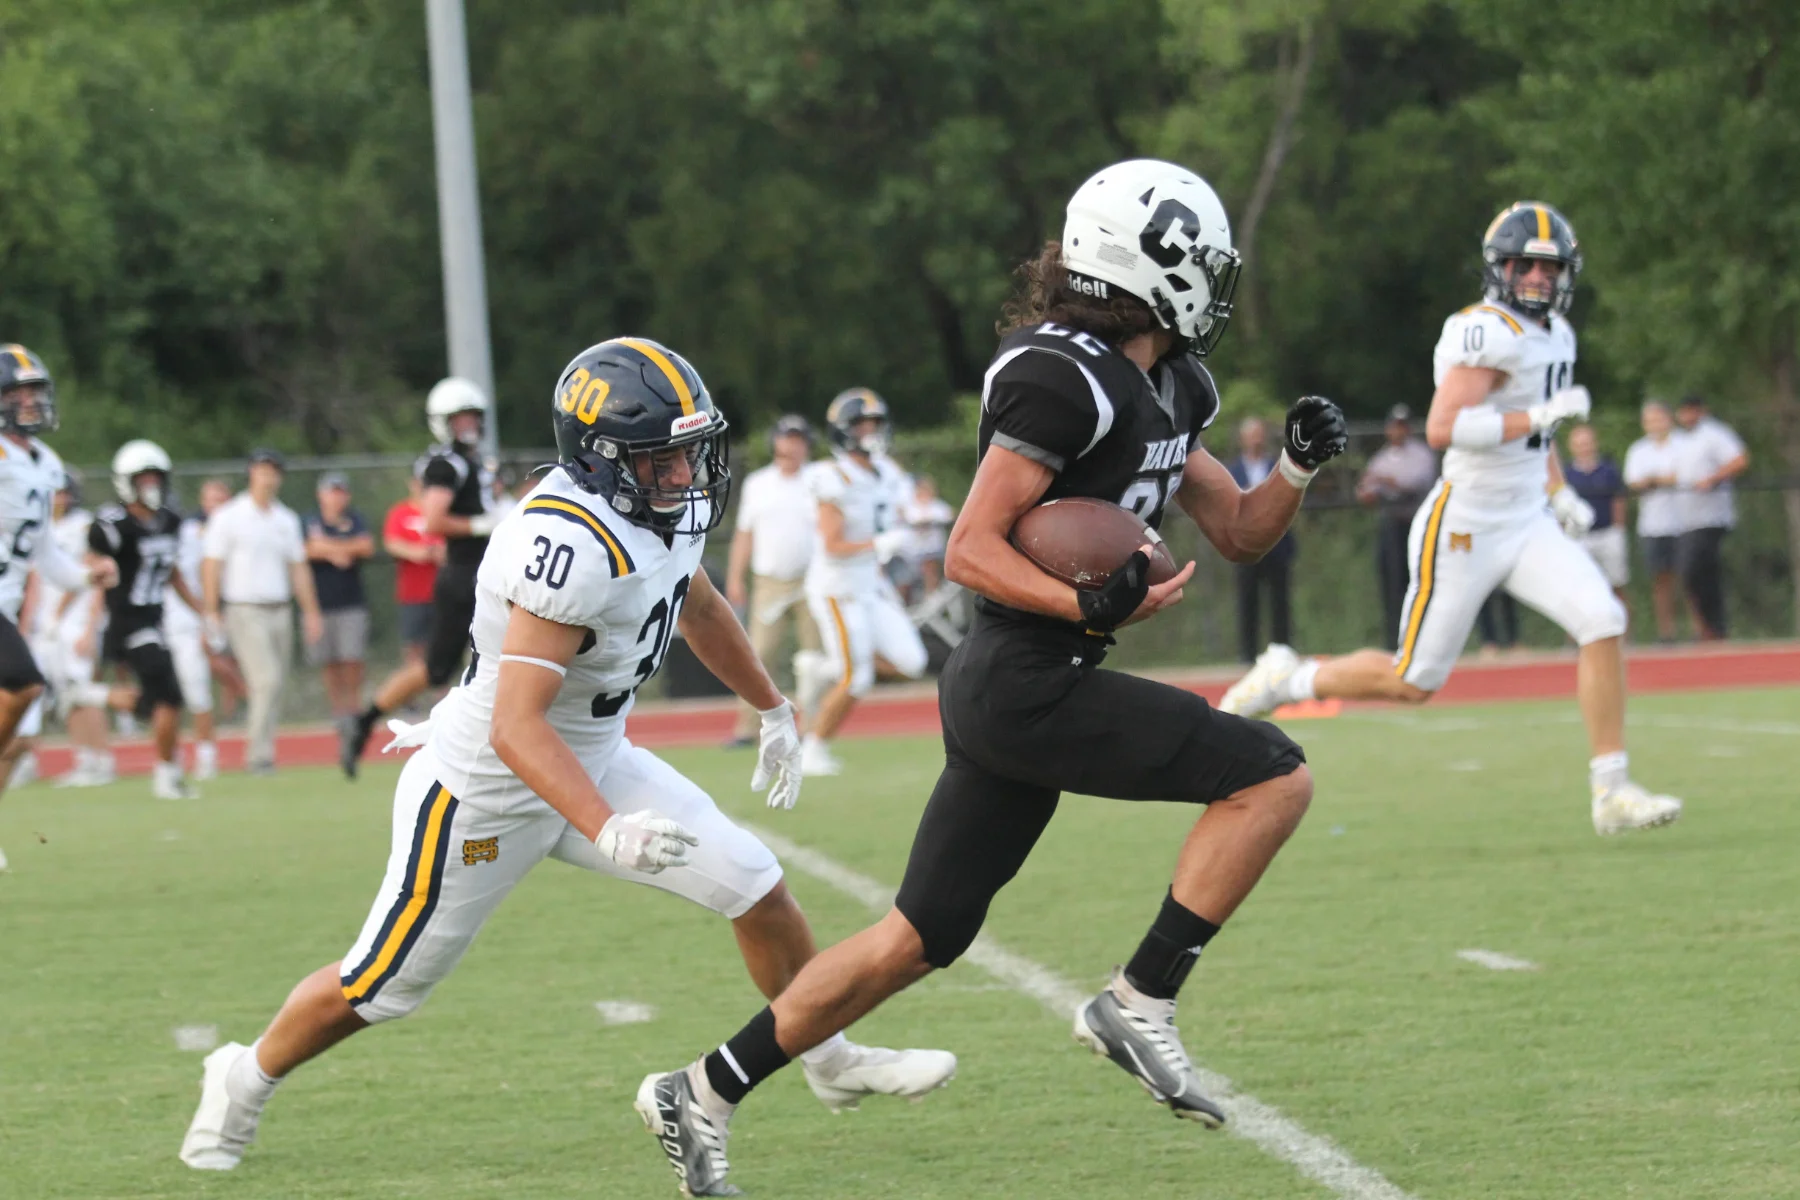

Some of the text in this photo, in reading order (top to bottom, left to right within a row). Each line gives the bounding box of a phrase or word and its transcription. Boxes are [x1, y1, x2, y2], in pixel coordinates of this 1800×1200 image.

[1463, 325, 1485, 351] 10
[561, 367, 610, 426] 30
[678, 415, 708, 431] Riddell
[524, 535, 575, 590] 30
